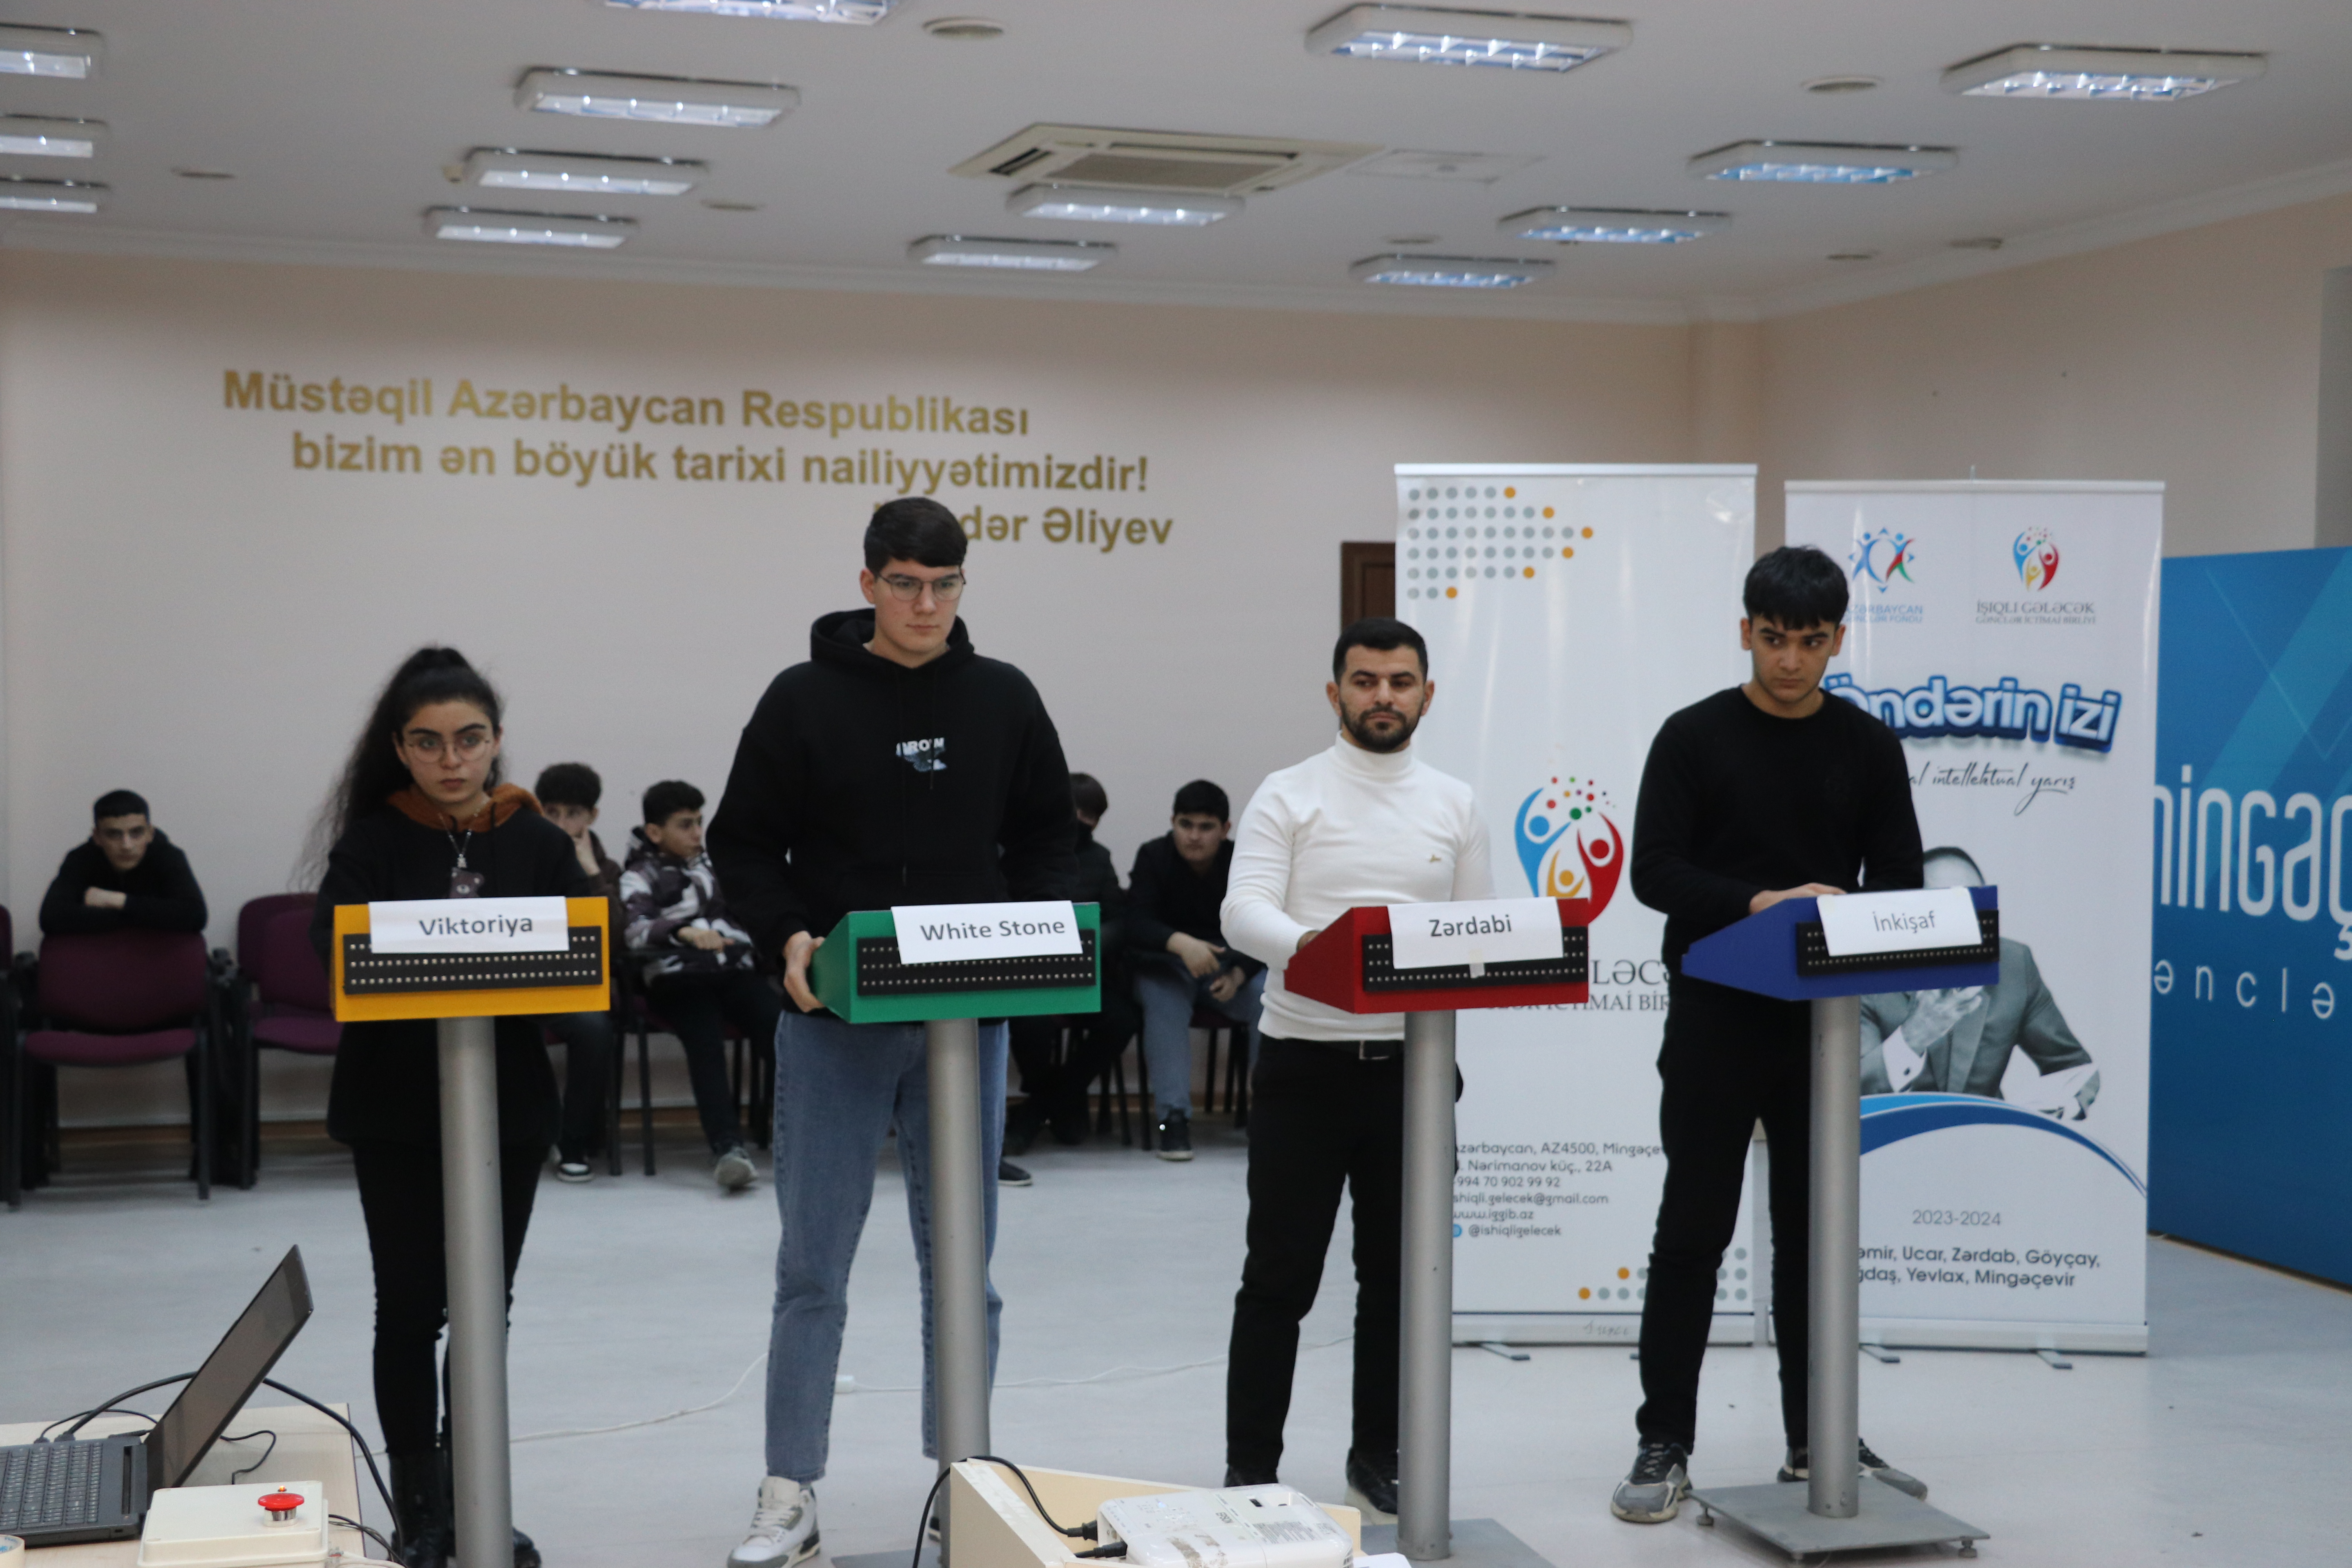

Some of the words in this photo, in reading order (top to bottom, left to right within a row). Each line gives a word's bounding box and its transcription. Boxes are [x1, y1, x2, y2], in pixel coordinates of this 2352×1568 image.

[223, 370, 432, 425] Müstəqil
[448, 379, 724, 433] Azərbaycan
[742, 390, 1028, 438] Respublikası
[292, 430, 422, 473] bizim
[440, 445, 496, 475] ən
[514, 439, 657, 488] böyük
[672, 445, 785, 482] tarixi
[803, 449, 1147, 495] nailiyyətimizdir!
[960, 505, 1029, 541] dər
[1042, 507, 1173, 554] Əliyev
[419, 915, 533, 937] Viktoriya
[920, 922, 992, 941] White
[999, 920, 1065, 937] Stone
[1429, 914, 1512, 938] Zərdabi
[1873, 910, 1935, 934] İnkişaf
[1459, 1142, 1537, 1157] zərbaycan,
[1586, 1160, 1613, 1172] 22A
[1484, 1176, 1498, 1187] 70
[1501, 1176, 1523, 1187] 902
[1528, 1177, 1542, 1187] 99
[1545, 1176, 1561, 1188] 92
[1912, 1209, 2002, 1226] 2023-2024
[1902, 1246, 1947, 1263] Ucar,
[1952, 1247, 2020, 1265] Zərdab,
[1907, 1267, 1969, 1285] Yevlax,
[1975, 1269, 2076, 1289] Mingəçevir
